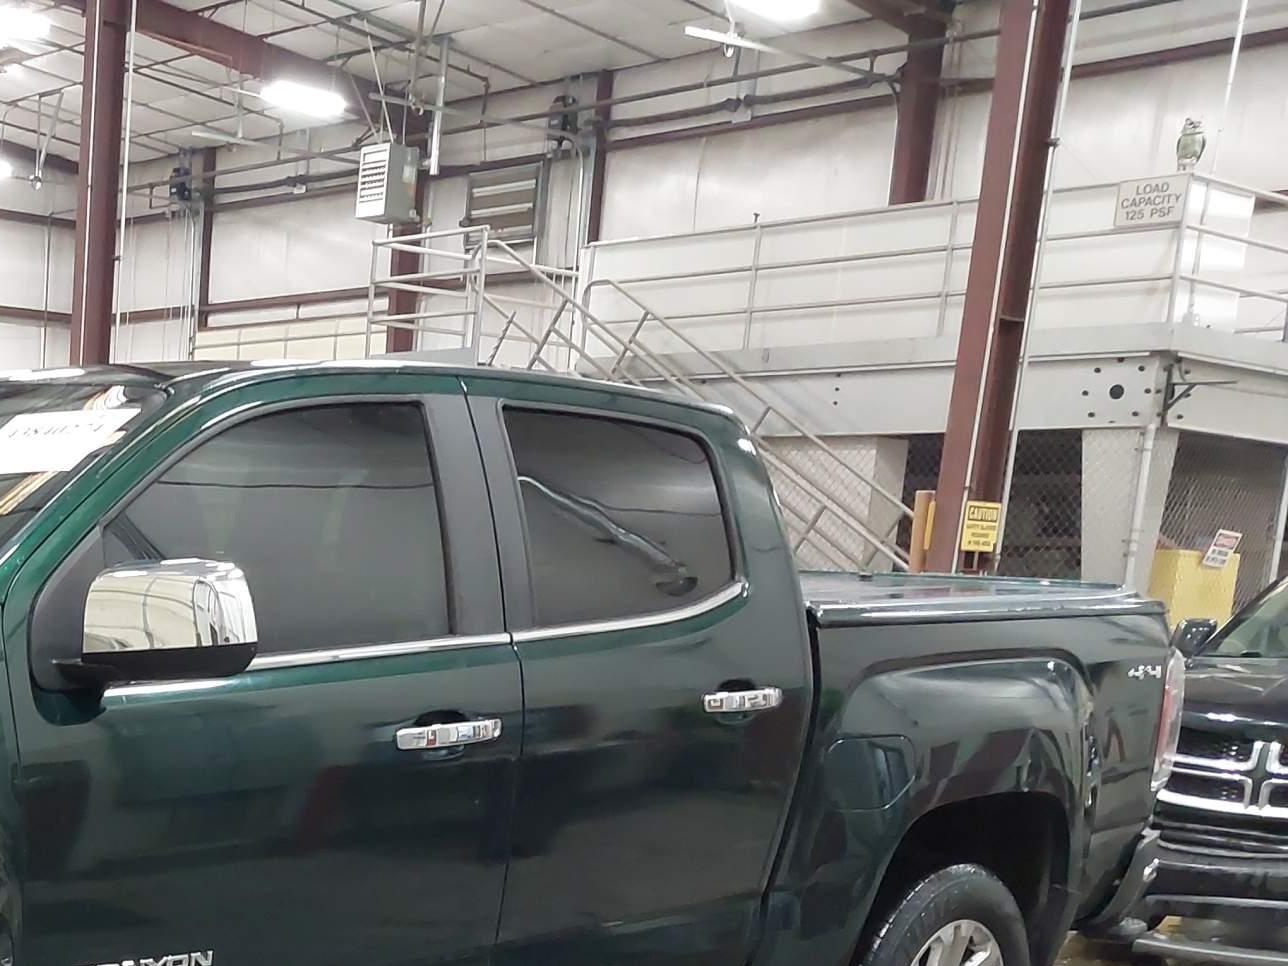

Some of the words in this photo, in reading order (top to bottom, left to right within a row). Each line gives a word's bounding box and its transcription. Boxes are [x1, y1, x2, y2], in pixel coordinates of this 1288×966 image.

[1136, 182, 1170, 196] LOAD
[1120, 193, 1182, 209] CAPACITY
[1125, 208, 1145, 221] 125
[1150, 205, 1175, 218] PSF
